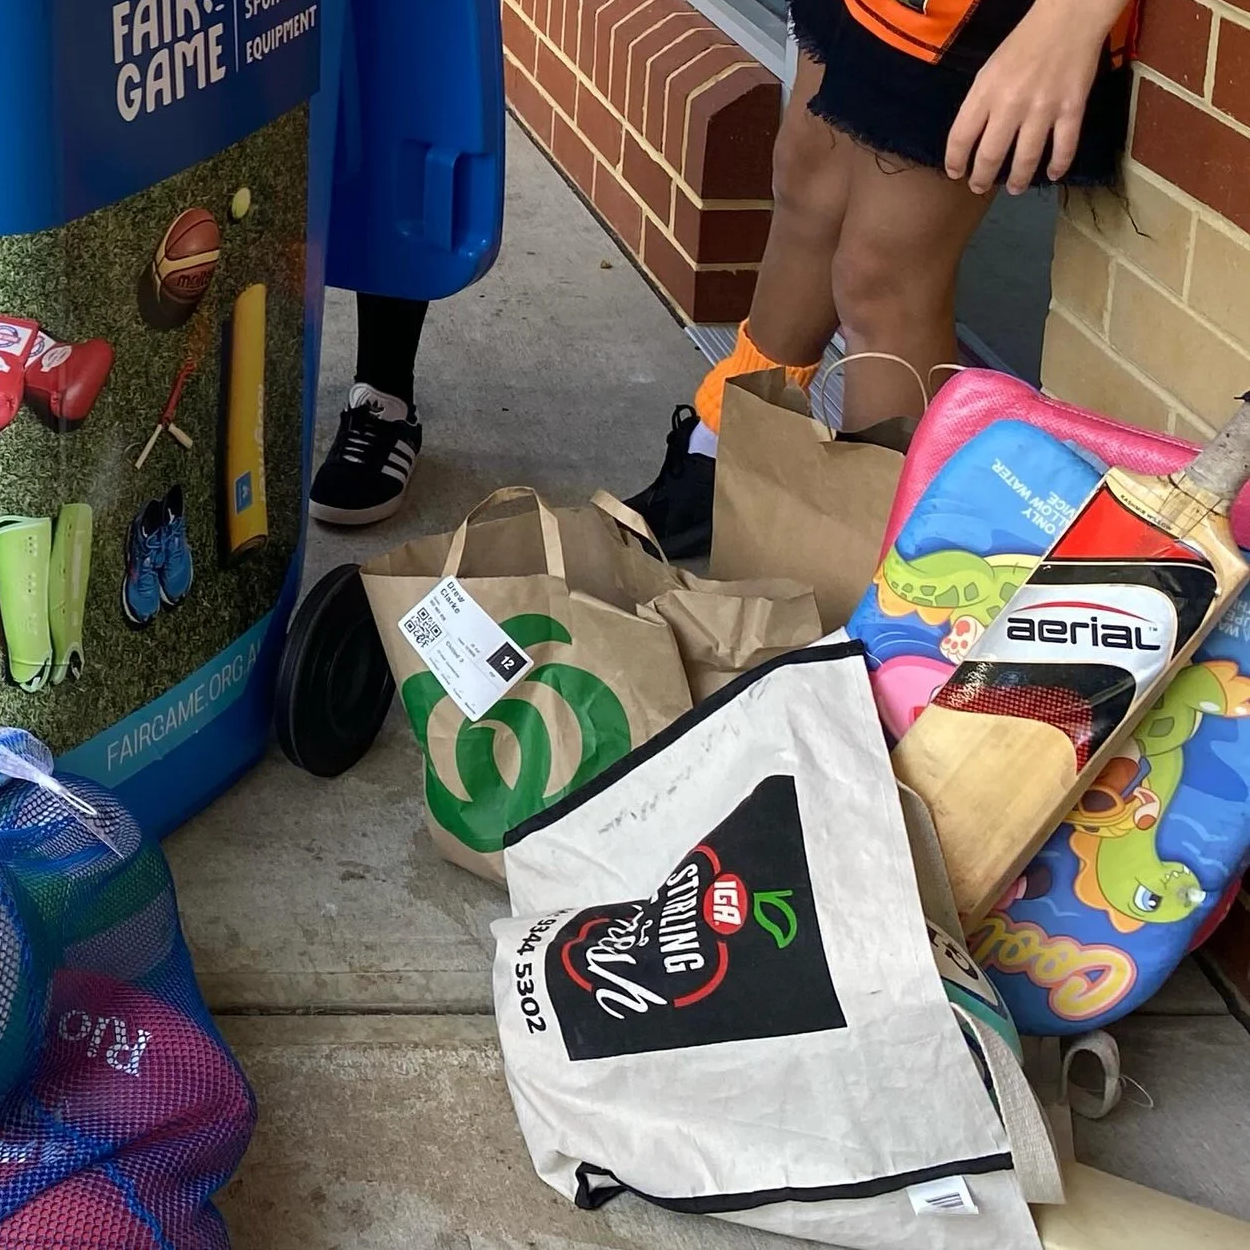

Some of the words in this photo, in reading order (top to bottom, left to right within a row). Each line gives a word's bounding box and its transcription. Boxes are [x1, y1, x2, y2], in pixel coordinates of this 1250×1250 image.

[246, 4, 317, 64] EQUIPMENT
[117, 23, 226, 122] GAME
[1020, 507, 1056, 534] ONLY
[447, 581, 465, 603] Drew
[1007, 616, 1161, 651] aerial
[500, 655, 515, 670] 12
[659, 863, 705, 974] STIRLING
[713, 880, 743, 926] IGA
[517, 918, 557, 956] 9344
[515, 963, 547, 1034] 5302
